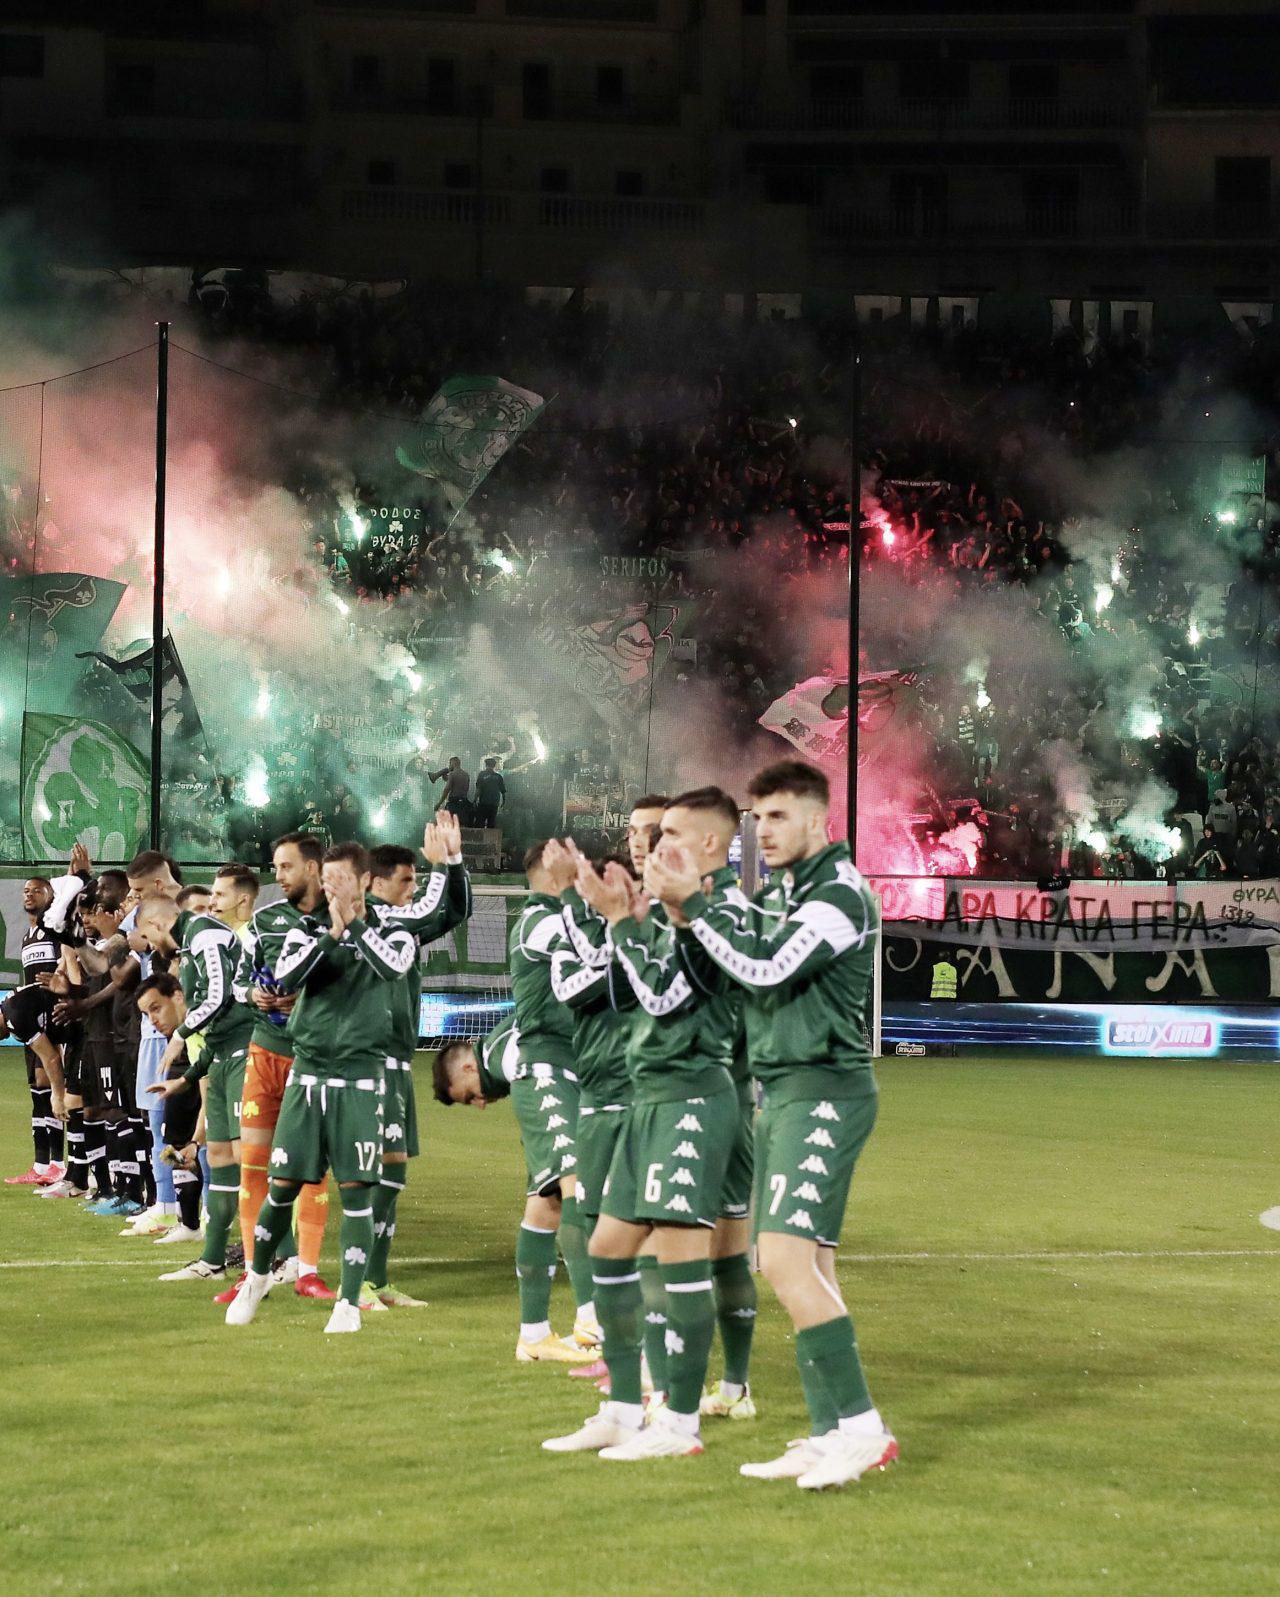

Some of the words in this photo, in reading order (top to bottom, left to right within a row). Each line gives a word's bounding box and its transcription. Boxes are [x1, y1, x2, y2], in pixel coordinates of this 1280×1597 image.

[601, 556, 668, 577] SERIFOS
[1233, 887, 1280, 903] ΘΥΡΑ
[354, 1141, 376, 1171] 17
[644, 1162, 664, 1203] 6
[768, 1173, 787, 1216] 7
